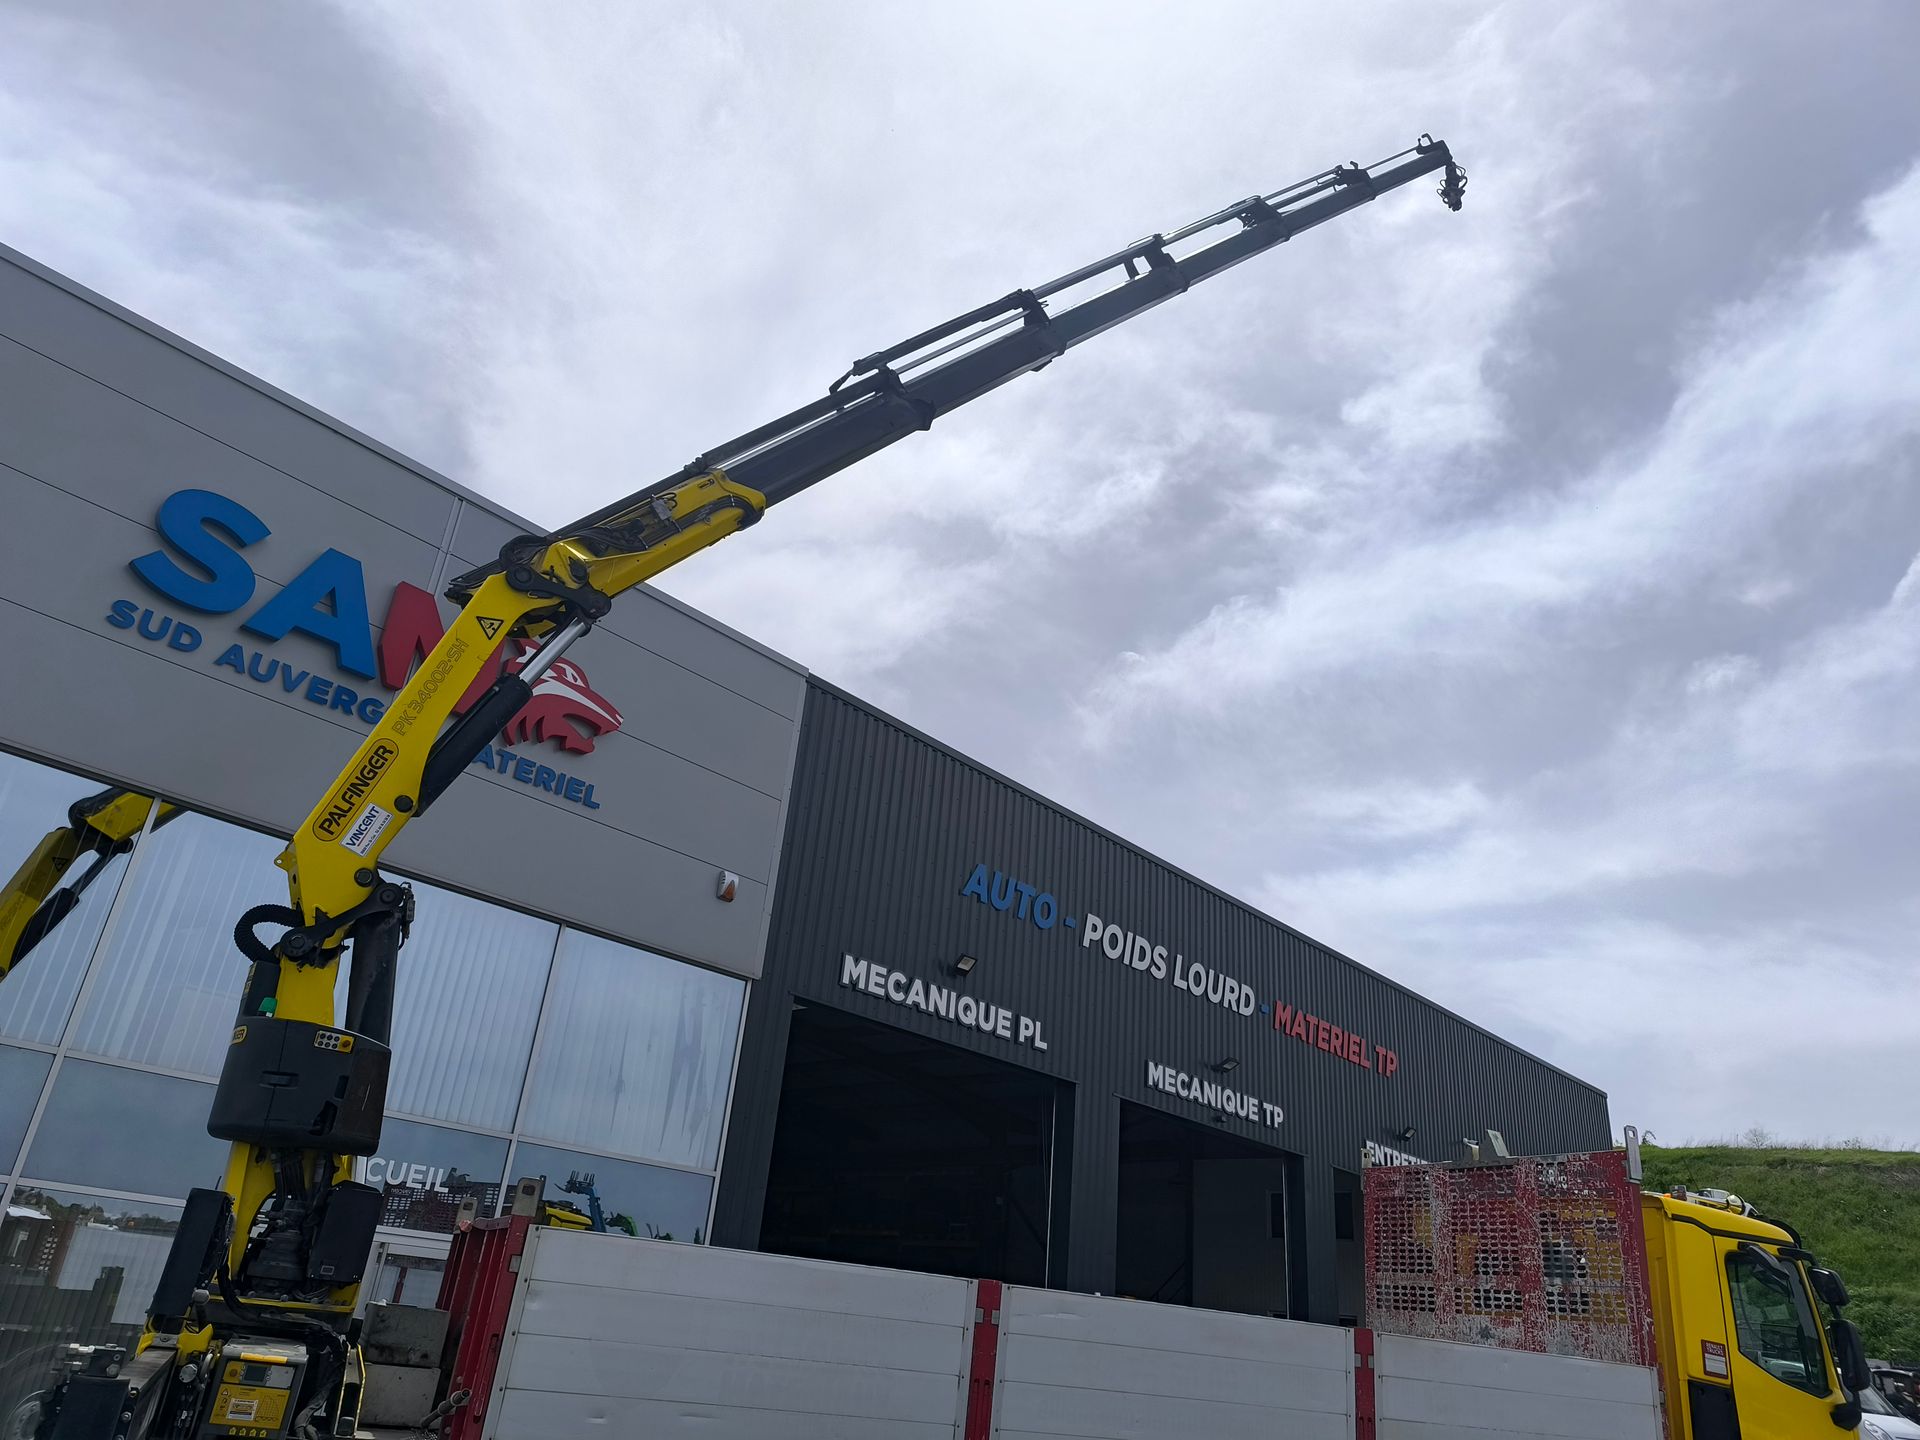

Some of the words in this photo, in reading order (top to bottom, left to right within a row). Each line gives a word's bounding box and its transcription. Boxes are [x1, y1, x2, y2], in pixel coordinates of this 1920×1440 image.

[105, 599, 203, 652] SUD
[213, 643, 385, 724] AUVERG
[472, 744, 600, 810] ATERIEL
[391, 709, 417, 736] PK
[318, 744, 394, 836] PALFINGER
[345, 806, 380, 847] VINCENT
[841, 954, 1012, 1039] MECANIQUE
[1018, 1015, 1048, 1050] PL
[962, 863, 1057, 930] AUTO
[1082, 912, 1168, 980] POIDS
[1172, 953, 1256, 1017] LOURD
[1272, 999, 1371, 1070] MATERIEL
[1375, 1045, 1398, 1078] TP
[1147, 1061, 1259, 1122] MECANIQUE
[1263, 1101, 1284, 1128] TP
[366, 1157, 449, 1193] CUEIL
